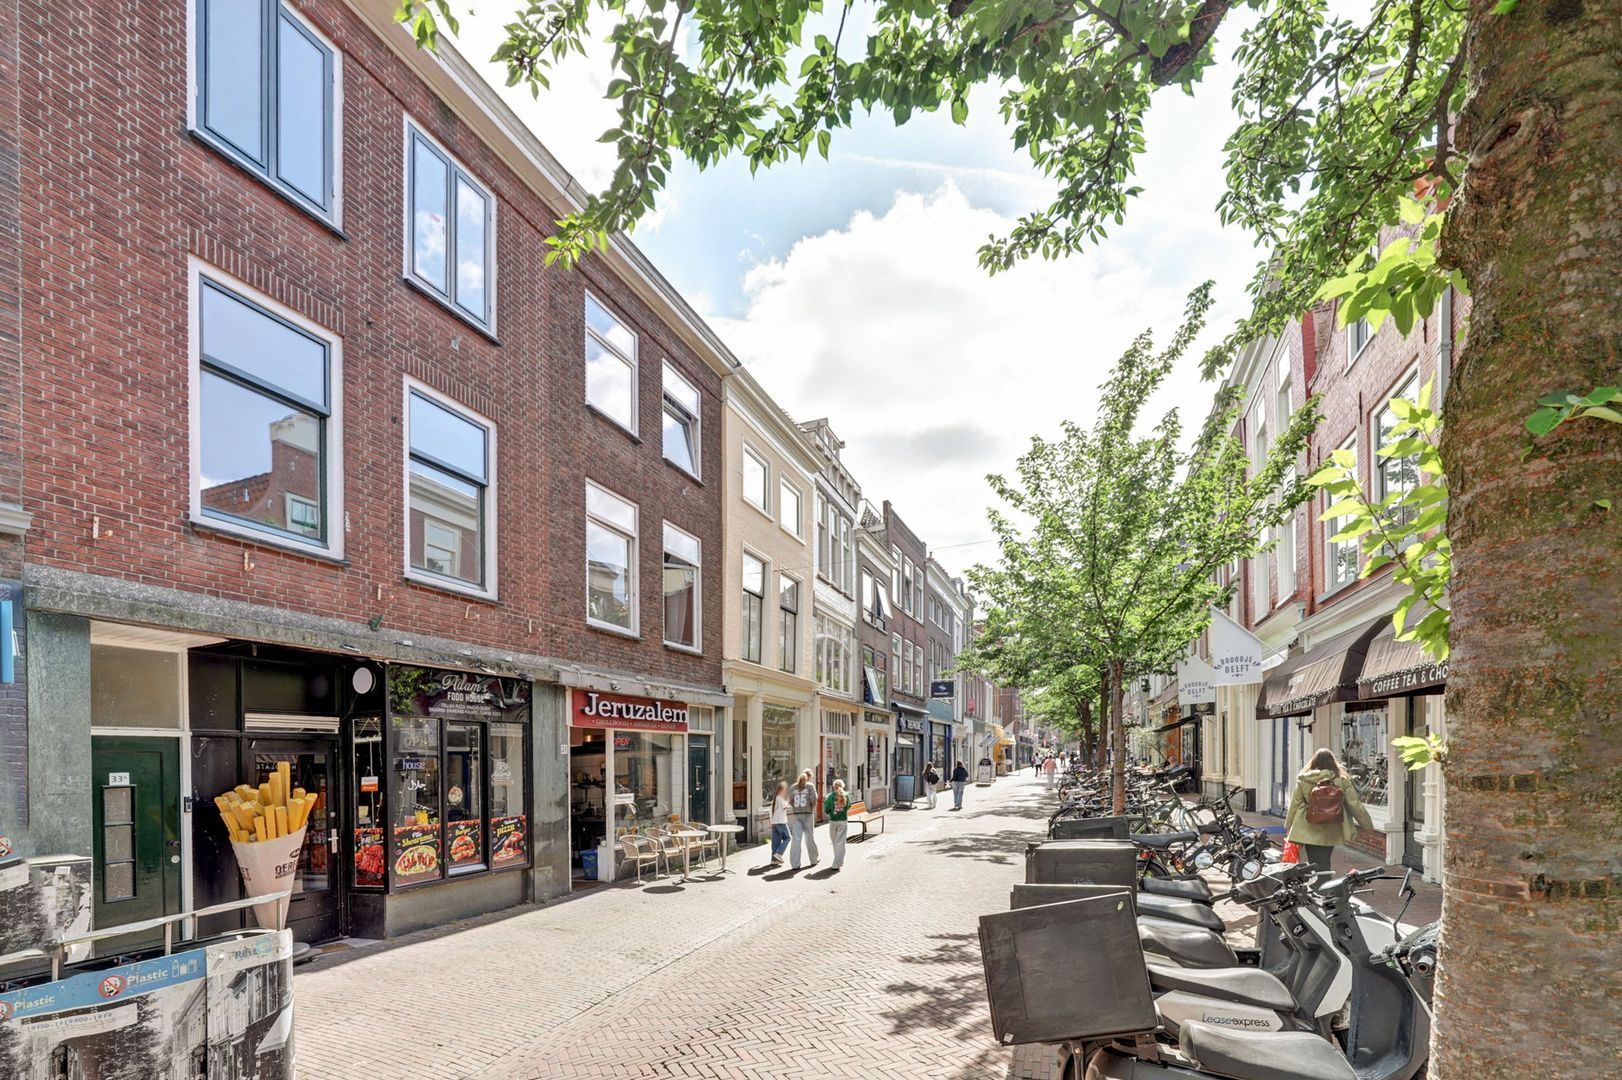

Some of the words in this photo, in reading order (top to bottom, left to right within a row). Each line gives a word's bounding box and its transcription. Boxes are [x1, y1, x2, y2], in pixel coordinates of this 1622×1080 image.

[1220, 656, 1252, 665] BROODJE
[1225, 664, 1250, 673] DELFT
[1373, 676, 1400, 693] COFFEE
[1402, 673, 1417, 687] TEA
[1421, 671, 1426, 683] &
[447, 691, 465, 702] FOOD
[465, 693, 486, 704] HOUSE
[584, 692, 688, 723] Jeruzalem
[402, 759, 426, 769] house
[127, 969, 168, 986] Plastic
[14, 995, 55, 1010] Plastic
